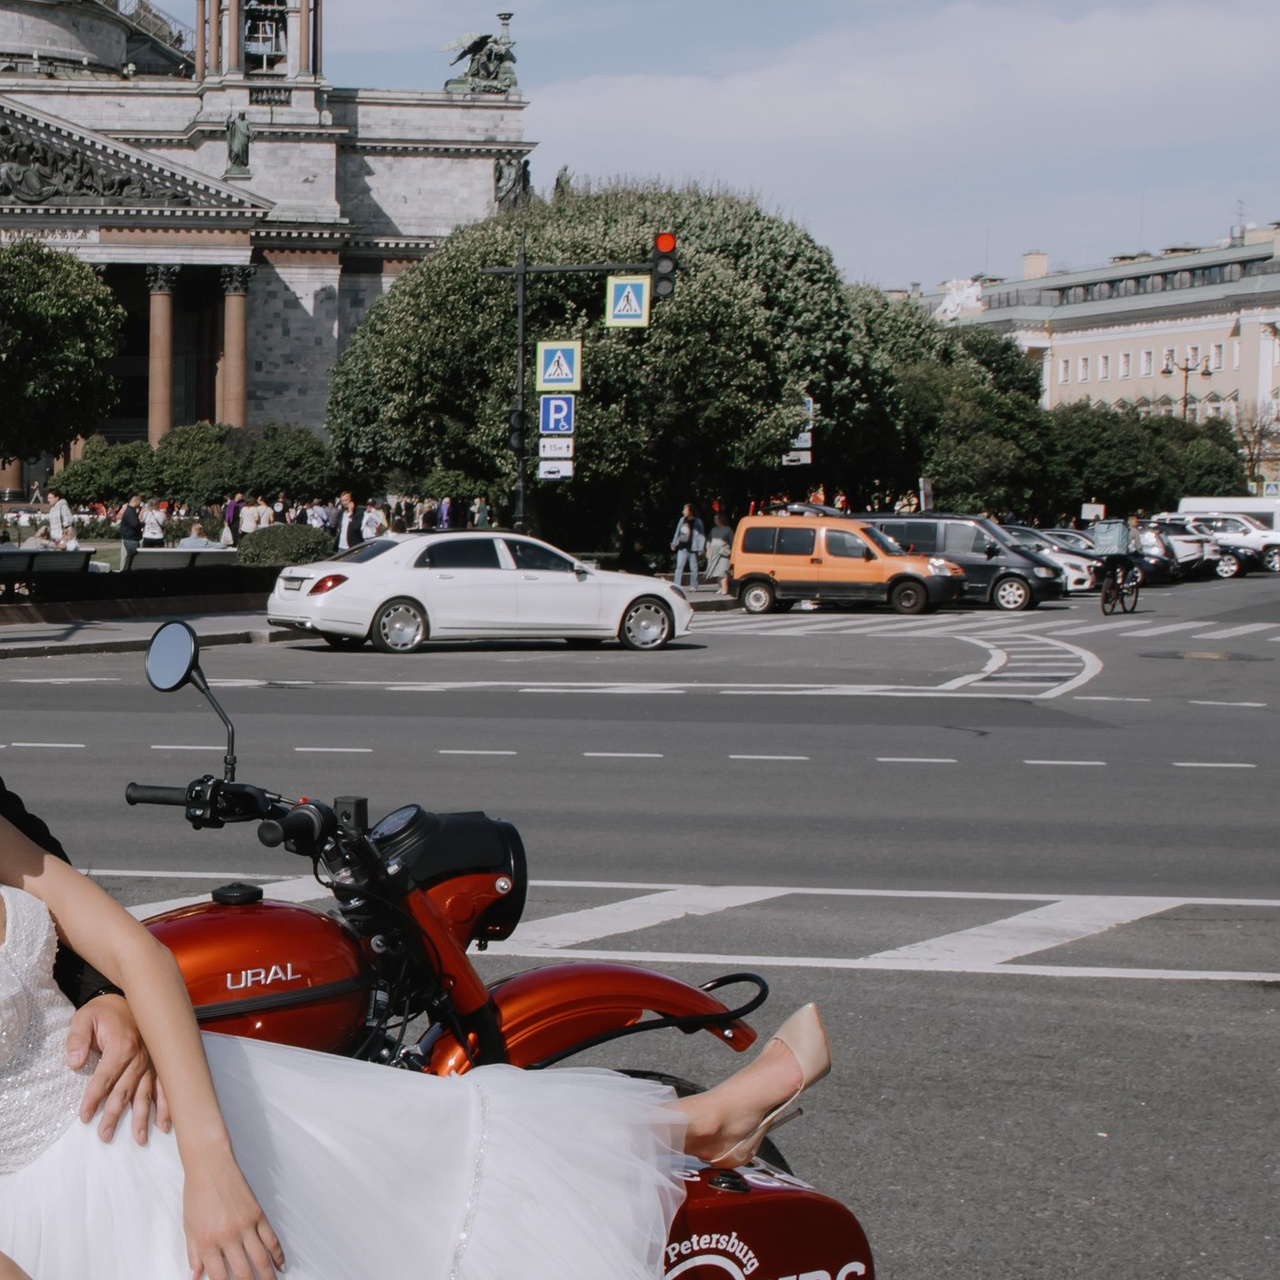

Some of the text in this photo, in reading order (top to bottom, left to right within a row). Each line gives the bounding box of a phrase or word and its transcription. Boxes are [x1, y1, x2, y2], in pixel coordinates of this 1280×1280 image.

[549, 399, 568, 429] P
[226, 962, 302, 990] URAL
[664, 1231, 760, 1275] Petersburg
